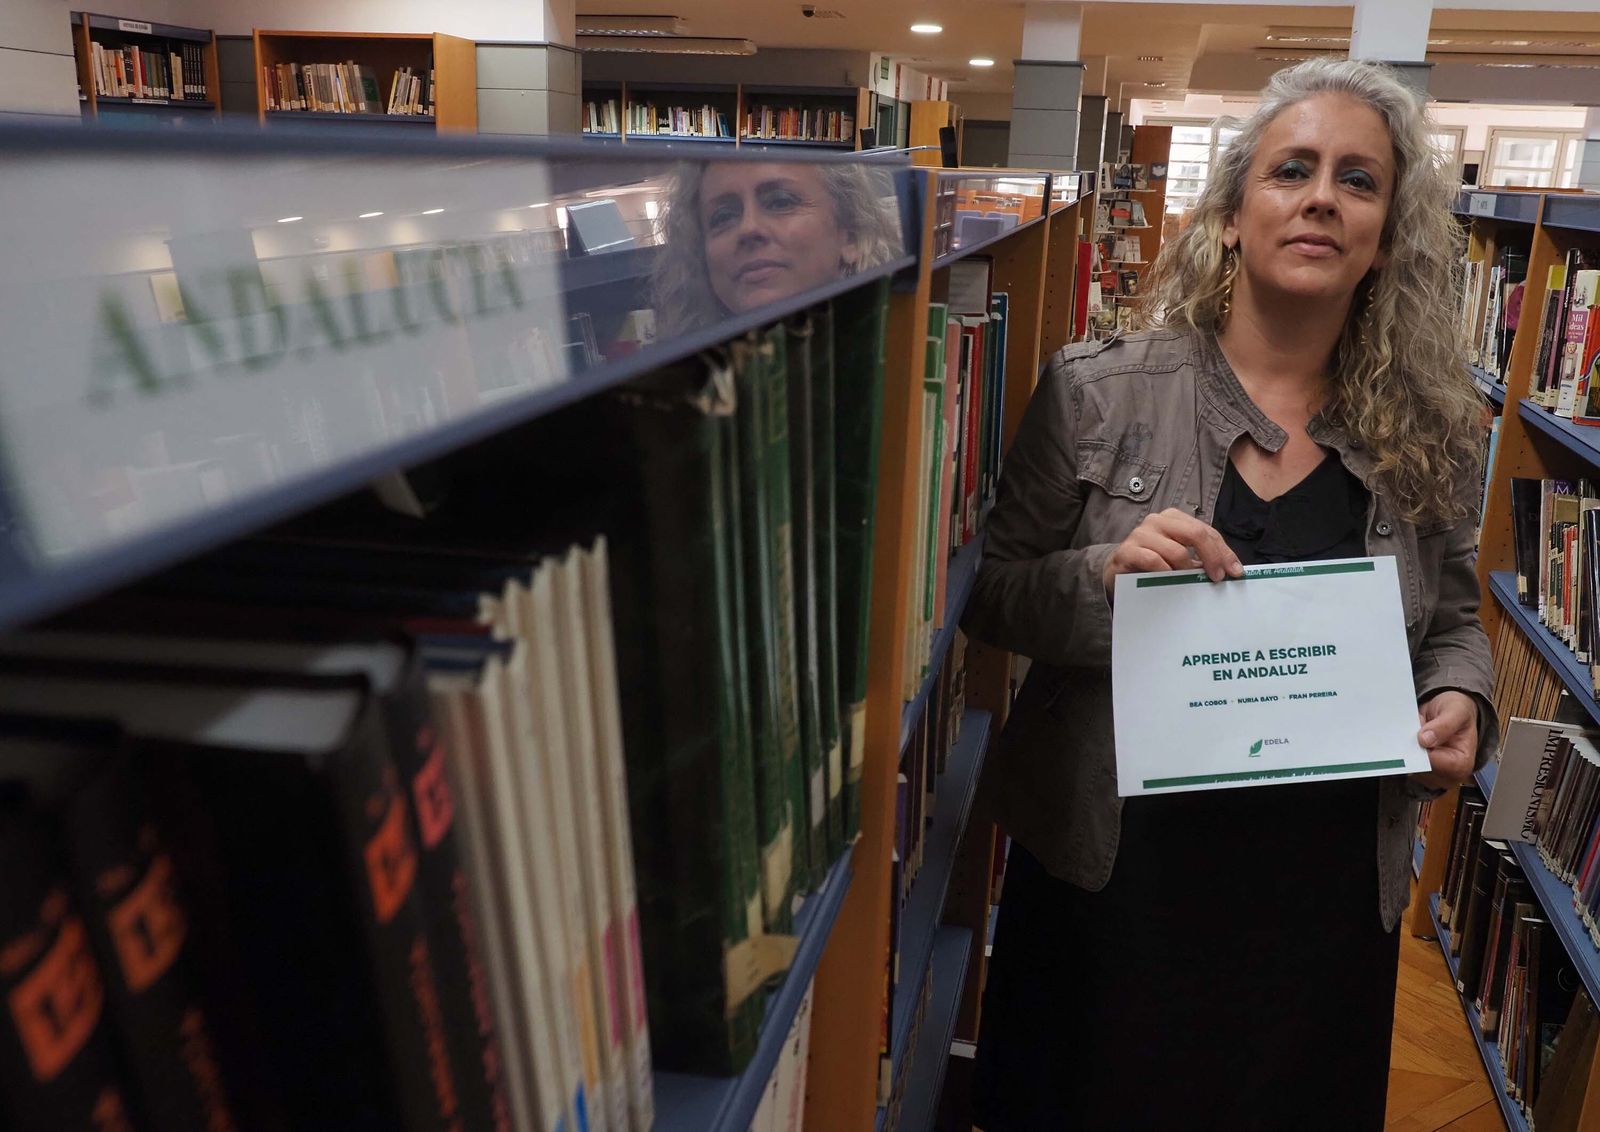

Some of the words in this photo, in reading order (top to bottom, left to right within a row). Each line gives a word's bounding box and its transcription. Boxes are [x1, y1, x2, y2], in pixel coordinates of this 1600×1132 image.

[1182, 651, 1251, 667] APRENDE
[1254, 650, 1266, 662] A
[1269, 645, 1337, 660] ESCRIBIR
[1213, 669, 1233, 681] EN
[1237, 664, 1308, 680] ANDALUZ
[1204, 699, 1228, 707] COBOS
[1260, 695, 1279, 703] BAYO
[1309, 691, 1338, 699] PEREIRA
[1264, 738, 1290, 746] EDELA
